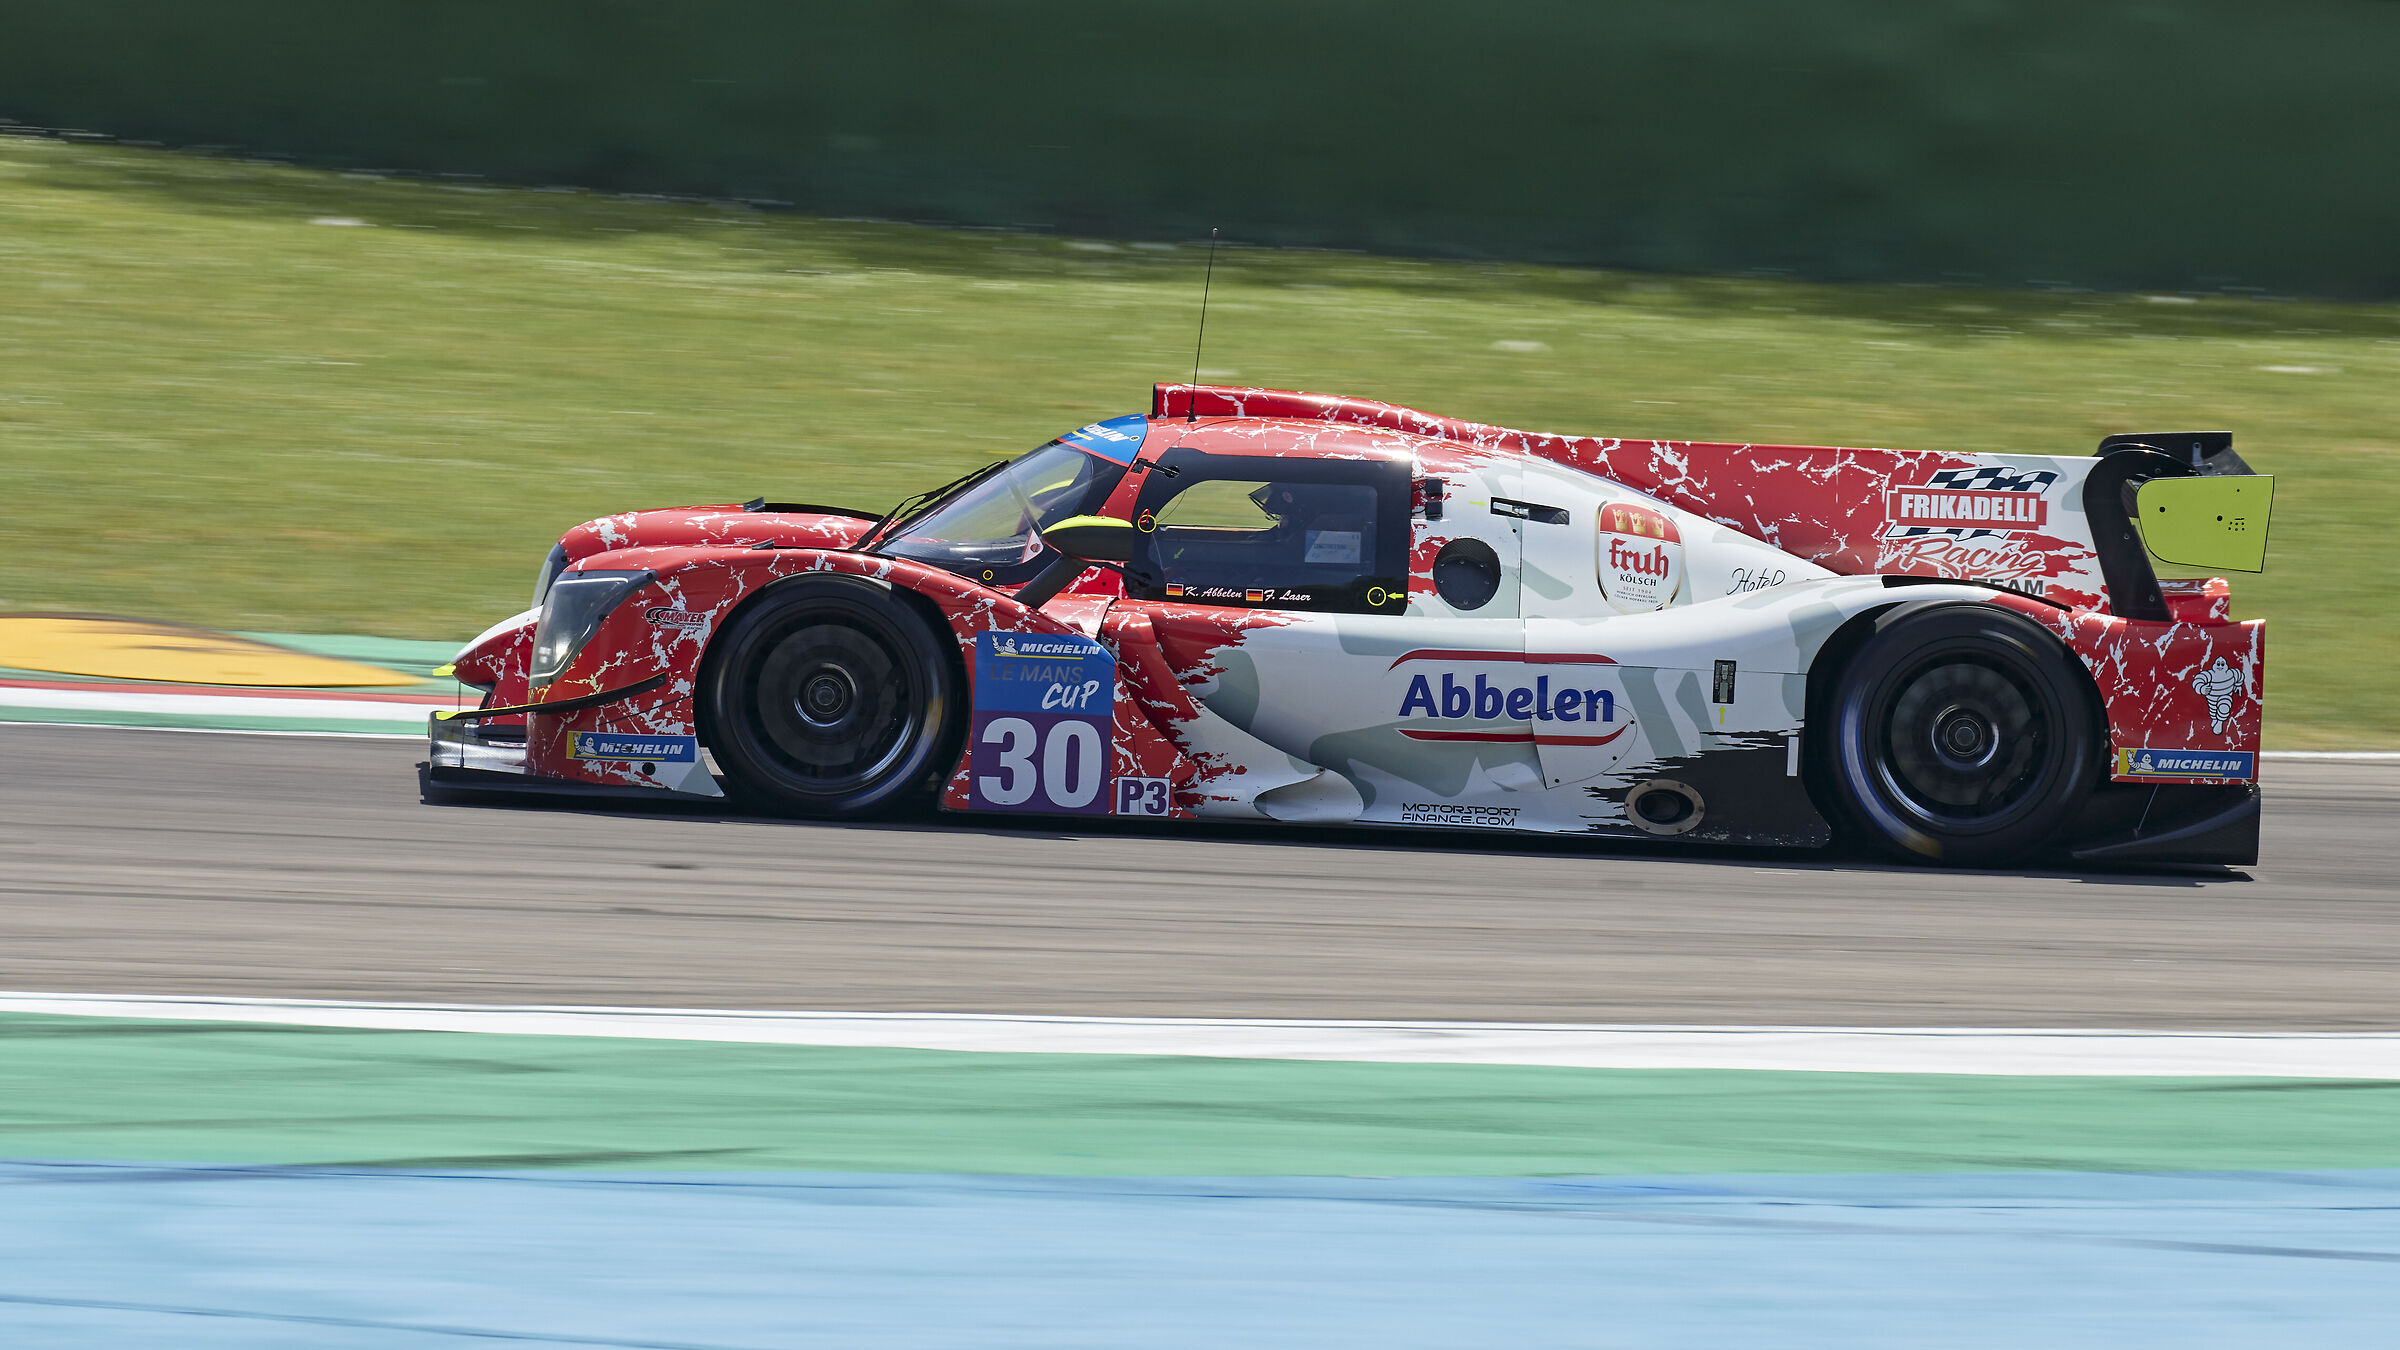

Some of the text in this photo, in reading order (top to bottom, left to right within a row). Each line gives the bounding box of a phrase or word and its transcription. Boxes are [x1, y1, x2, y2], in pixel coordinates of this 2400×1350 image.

[1900, 493, 2037, 522] FRIKADELLI
[1902, 537, 2045, 580] Racing
[1619, 573, 1657, 586] KÖLSCH
[1972, 577, 2044, 595] AM
[1184, 586, 1242, 599] K. Abbelen
[1263, 589, 1311, 601] F. Laser
[662, 611, 706, 623] MAYER
[1020, 643, 1100, 655] MICHELIN
[990, 663, 1084, 684] LE MANS
[1041, 680, 1100, 710] CUP
[1398, 672, 1615, 723] Abbelen
[978, 717, 1103, 808] 30
[2157, 758, 2242, 771] MICHELIN
[1119, 779, 1168, 815] P3
[1402, 802, 1521, 816] MOTORSPORT
[1401, 813, 1515, 827] FINANCE.COM
